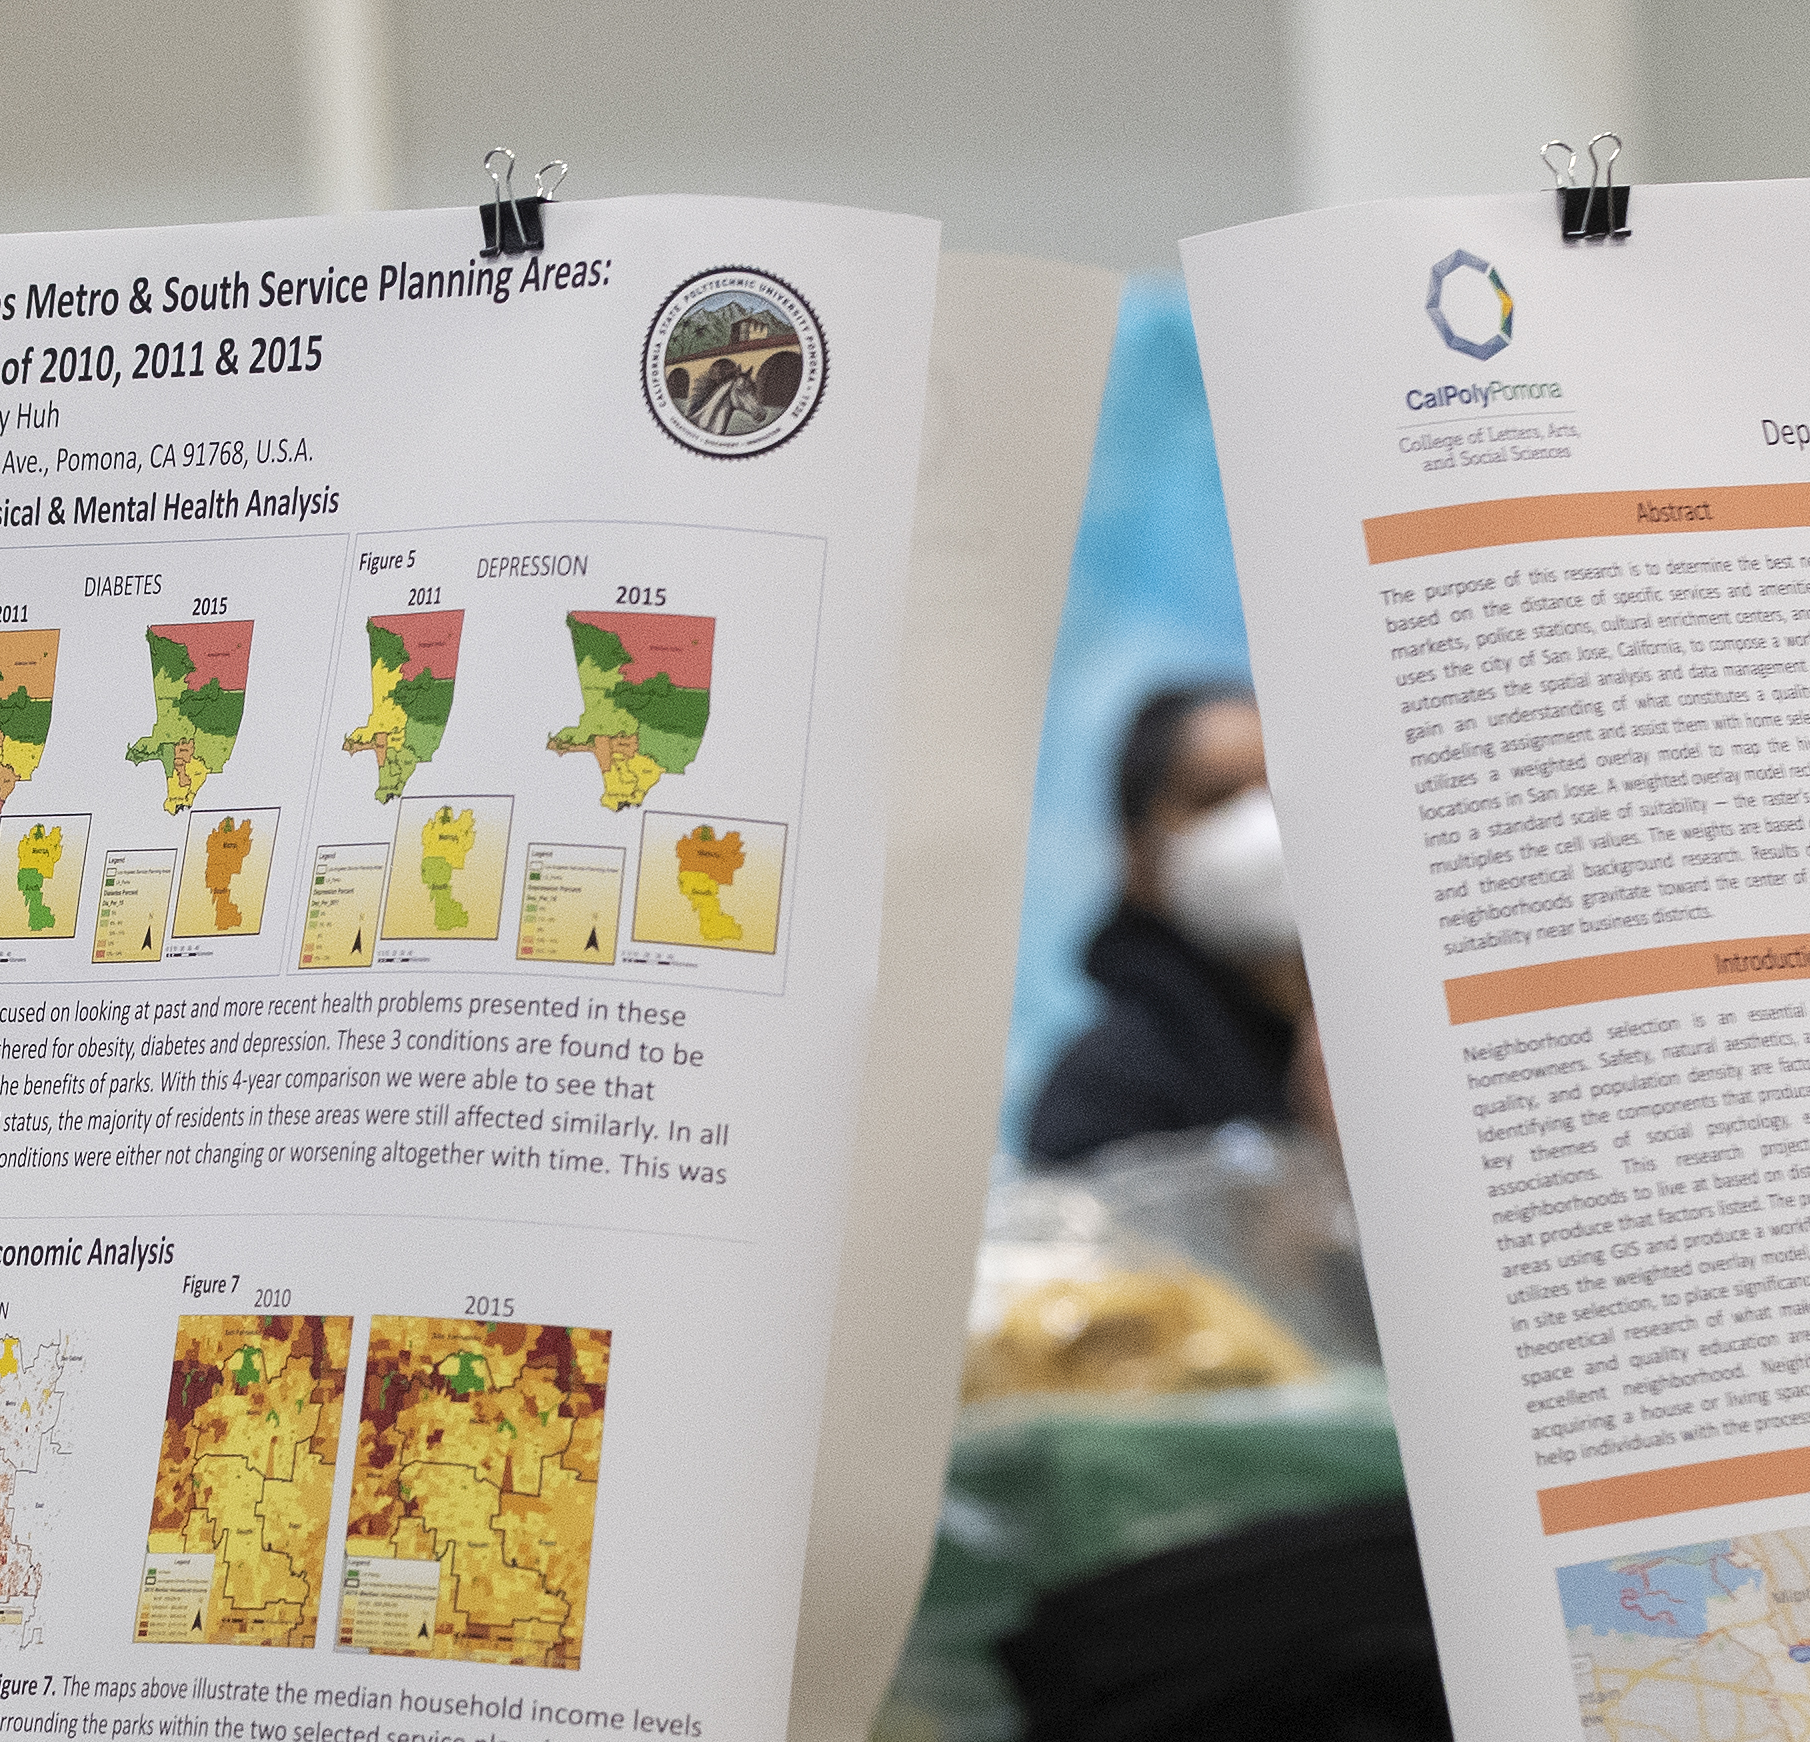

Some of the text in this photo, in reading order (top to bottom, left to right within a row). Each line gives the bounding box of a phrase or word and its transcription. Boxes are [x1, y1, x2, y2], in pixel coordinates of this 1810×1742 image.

[25, 282, 120, 320] Metro
[128, 275, 153, 316] &
[161, 270, 250, 314] South
[258, 265, 369, 309] Service
[379, 261, 511, 305] Planning
[520, 256, 613, 292] Areas:
[0, 345, 35, 386] of
[39, 344, 122, 388] 2010,
[131, 340, 205, 380] 2011
[214, 337, 239, 376] &
[248, 334, 323, 375] 2015
[1405, 380, 1562, 412] CalPolyPomona
[16, 400, 60, 430] Huh
[47, 496, 66, 526] &
[73, 492, 158, 524] Mental
[163, 488, 240, 521] Health
[244, 485, 340, 522] Analysis
[1637, 501, 1713, 524] Abstract
[358, 549, 416, 576] Figure 5
[476, 554, 588, 580] DEPRESSION
[84, 574, 162, 597] DIABETES
[407, 586, 441, 607] 2011
[616, 586, 666, 606] 2015
[192, 597, 228, 616] 2015
[87, 1235, 175, 1272] Analysis
[182, 1274, 241, 1299] Figure 7
[253, 1287, 292, 1309] 2010
[464, 1295, 515, 1318] 2015
